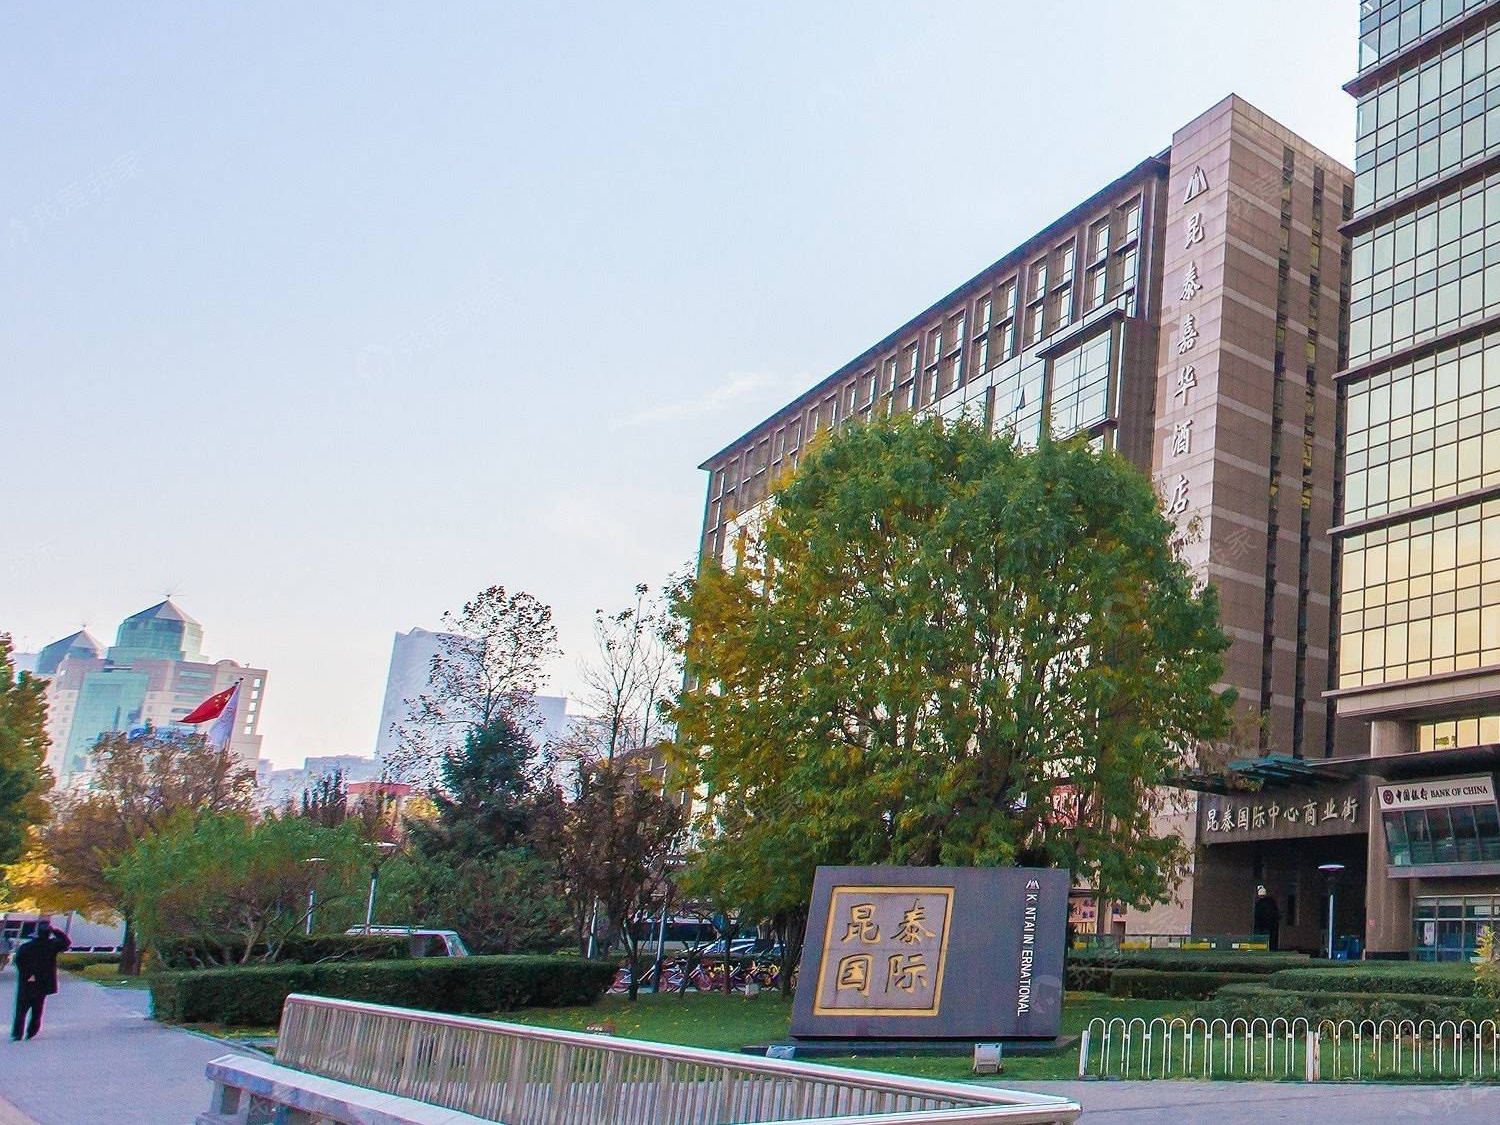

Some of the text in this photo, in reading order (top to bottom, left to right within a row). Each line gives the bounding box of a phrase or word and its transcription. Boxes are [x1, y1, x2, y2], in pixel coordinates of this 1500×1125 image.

[1167, 212, 1204, 514] 昆泰嘉华酒店
[1396, 785, 1488, 802] 中国银行 BANK OF CHINA
[1206, 796, 1358, 832] 昆泰国际中心商业街
[841, 898, 936, 946] 昆泰
[1024, 894, 1038, 931] KNTAI
[836, 953, 928, 997] 国际
